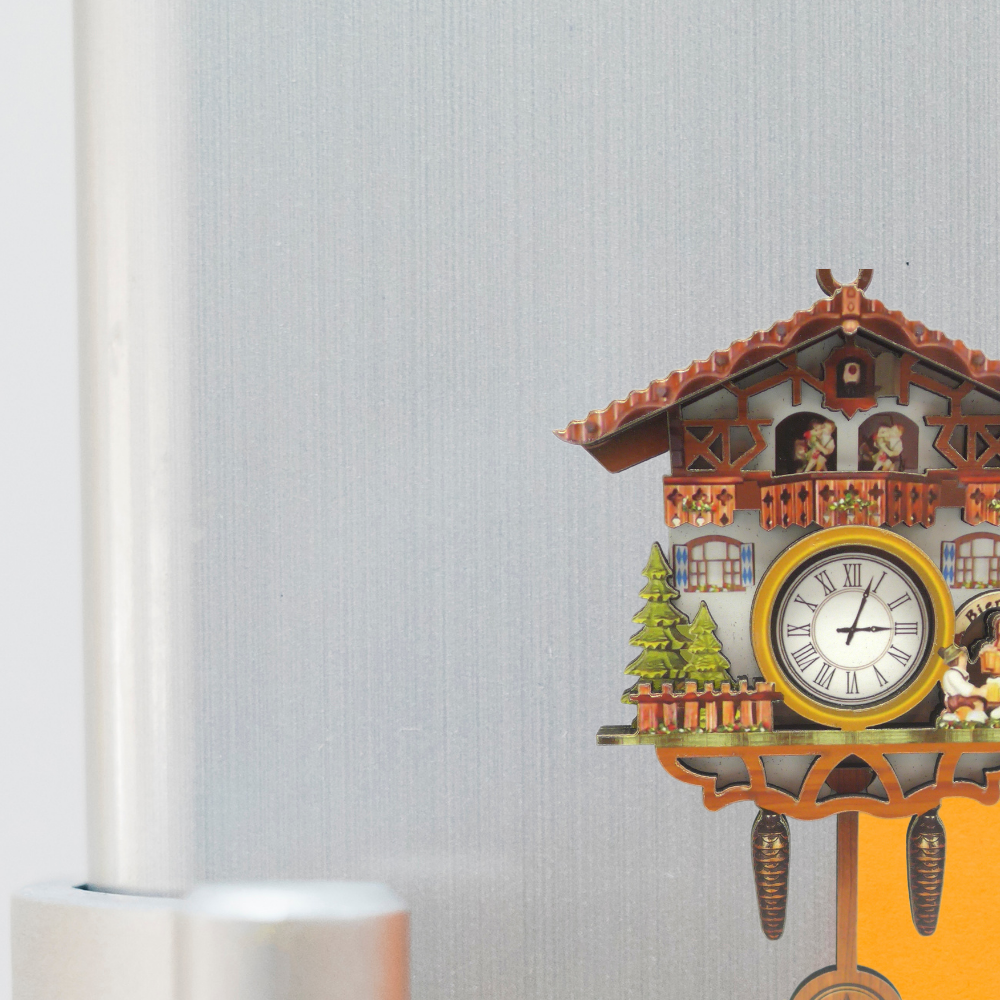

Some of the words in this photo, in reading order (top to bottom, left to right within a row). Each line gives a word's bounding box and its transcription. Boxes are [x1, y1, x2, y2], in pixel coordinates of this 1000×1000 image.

[814, 570, 837, 596] XI
[843, 563, 862, 587] XII
[872, 571, 887, 593] I
[794, 594, 818, 612] X
[887, 592, 912, 611] II
[787, 623, 810, 637] IX
[895, 622, 918, 635] III
[791, 642, 820, 672] VIII
[888, 645, 912, 667] IV
[813, 662, 836, 690] VII
[846, 671, 860, 694] VI
[873, 665, 888, 687] V
